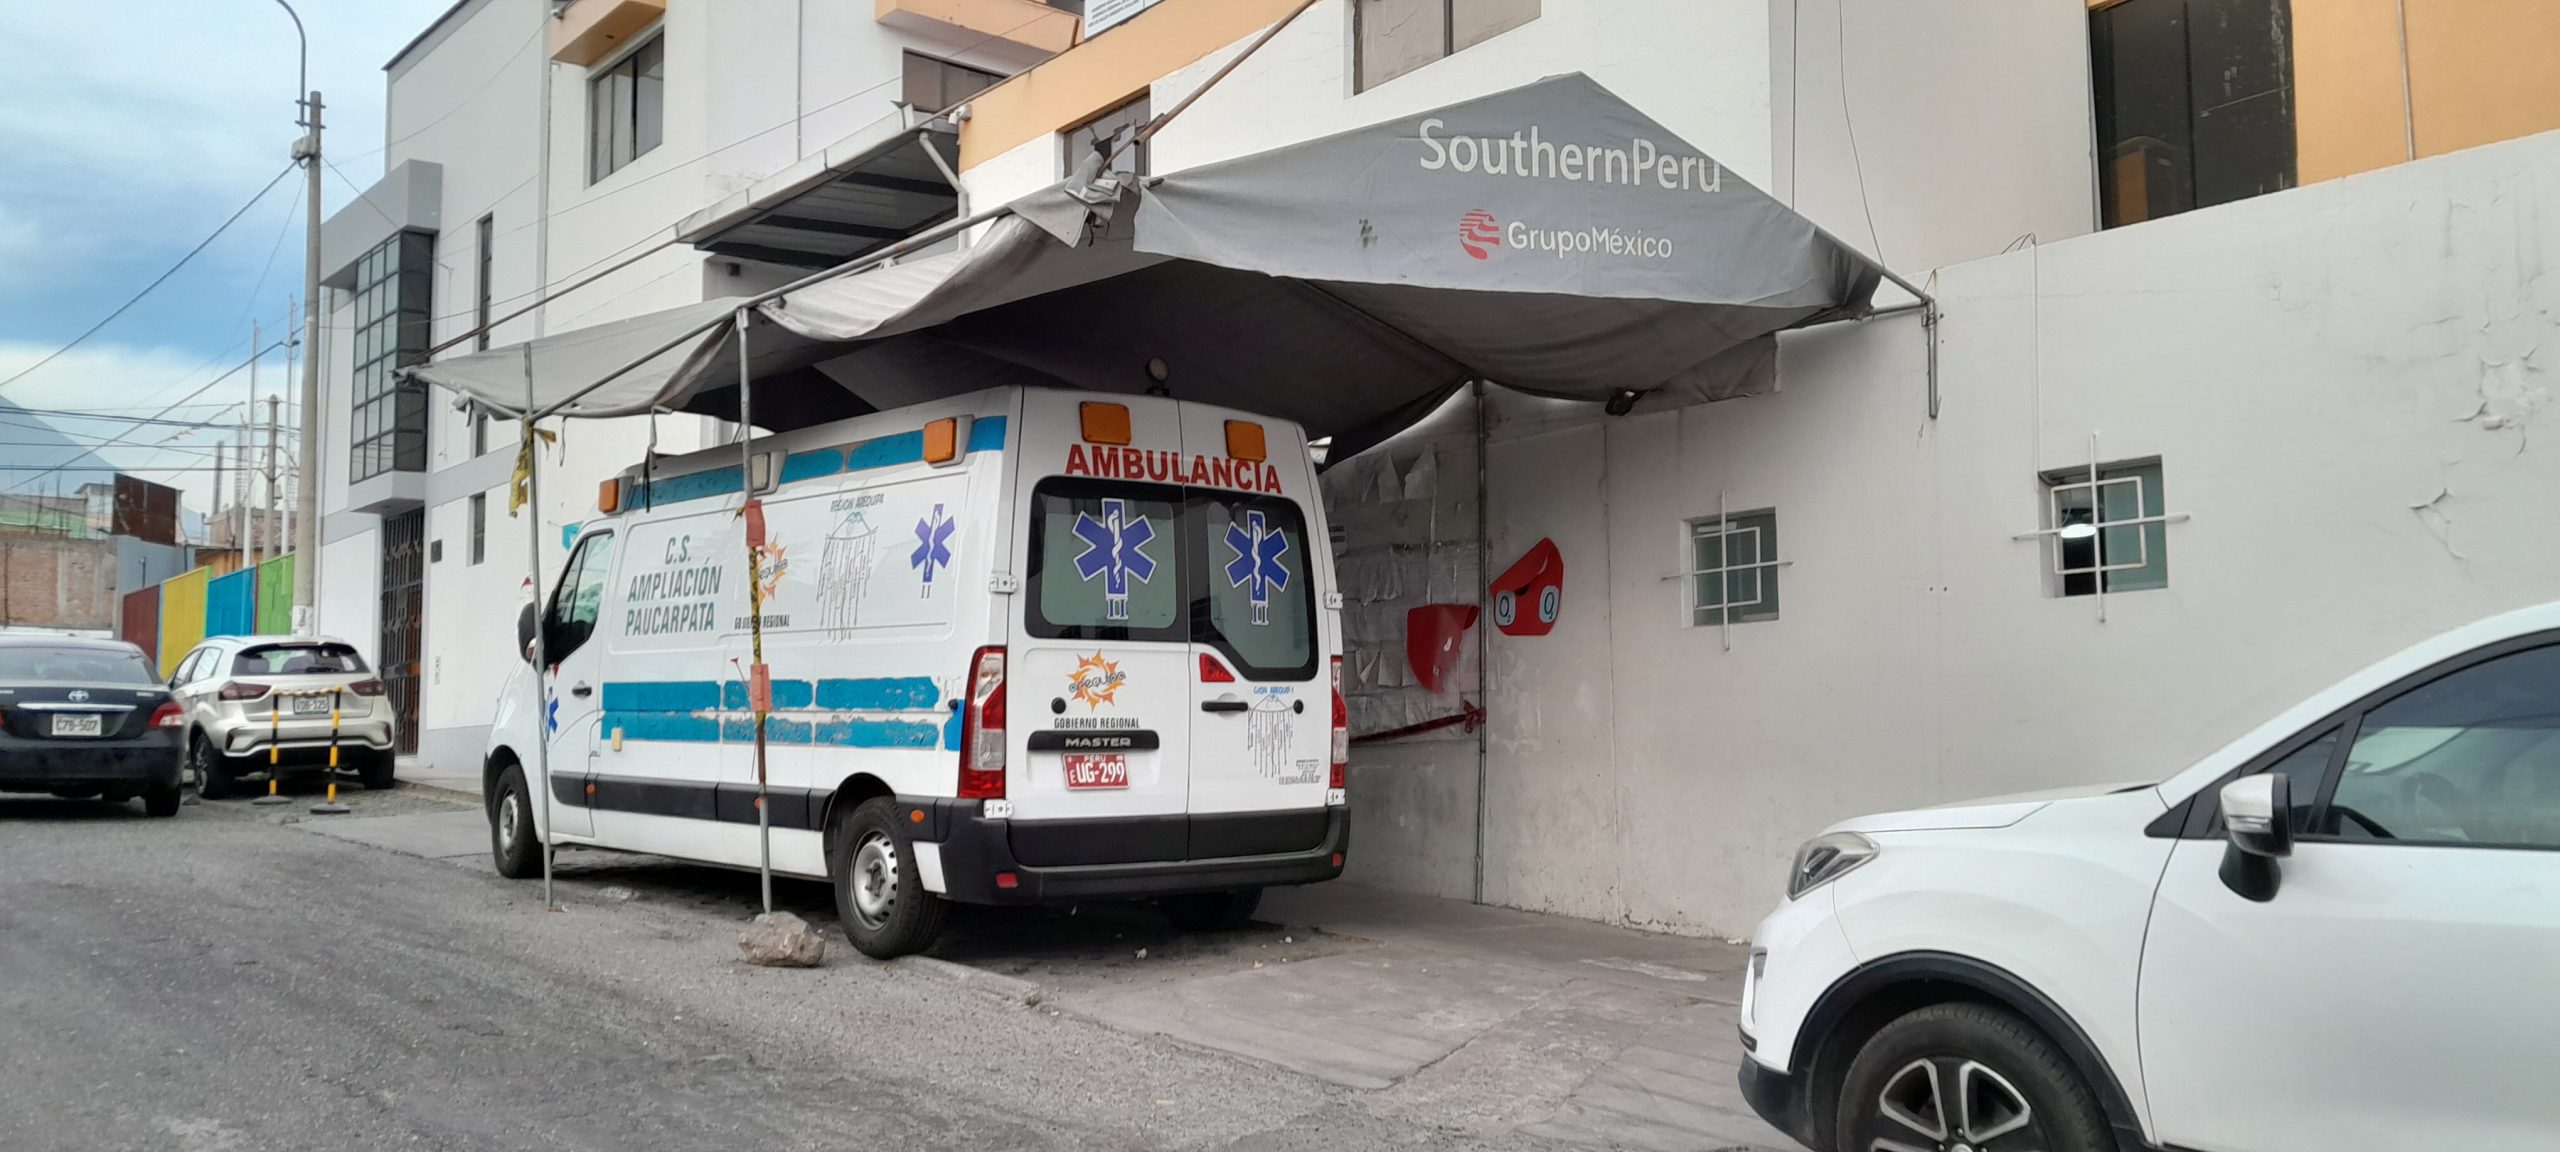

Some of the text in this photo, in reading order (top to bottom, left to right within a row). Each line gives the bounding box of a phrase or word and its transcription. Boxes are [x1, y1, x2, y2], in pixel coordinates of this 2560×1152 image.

[1418, 118, 1722, 194] SouthernPeru
[1507, 220, 1674, 260] GrupoMéxico
[1064, 443, 1283, 495] AMBULANCIA
[665, 534, 692, 565] C.S.
[627, 556, 723, 603] AMPLIACIÓN
[624, 601, 715, 637] PAUCARPATA
[1054, 717, 1140, 729] GOBIERNO REGIONAL
[1065, 738, 1131, 747] MASTER
